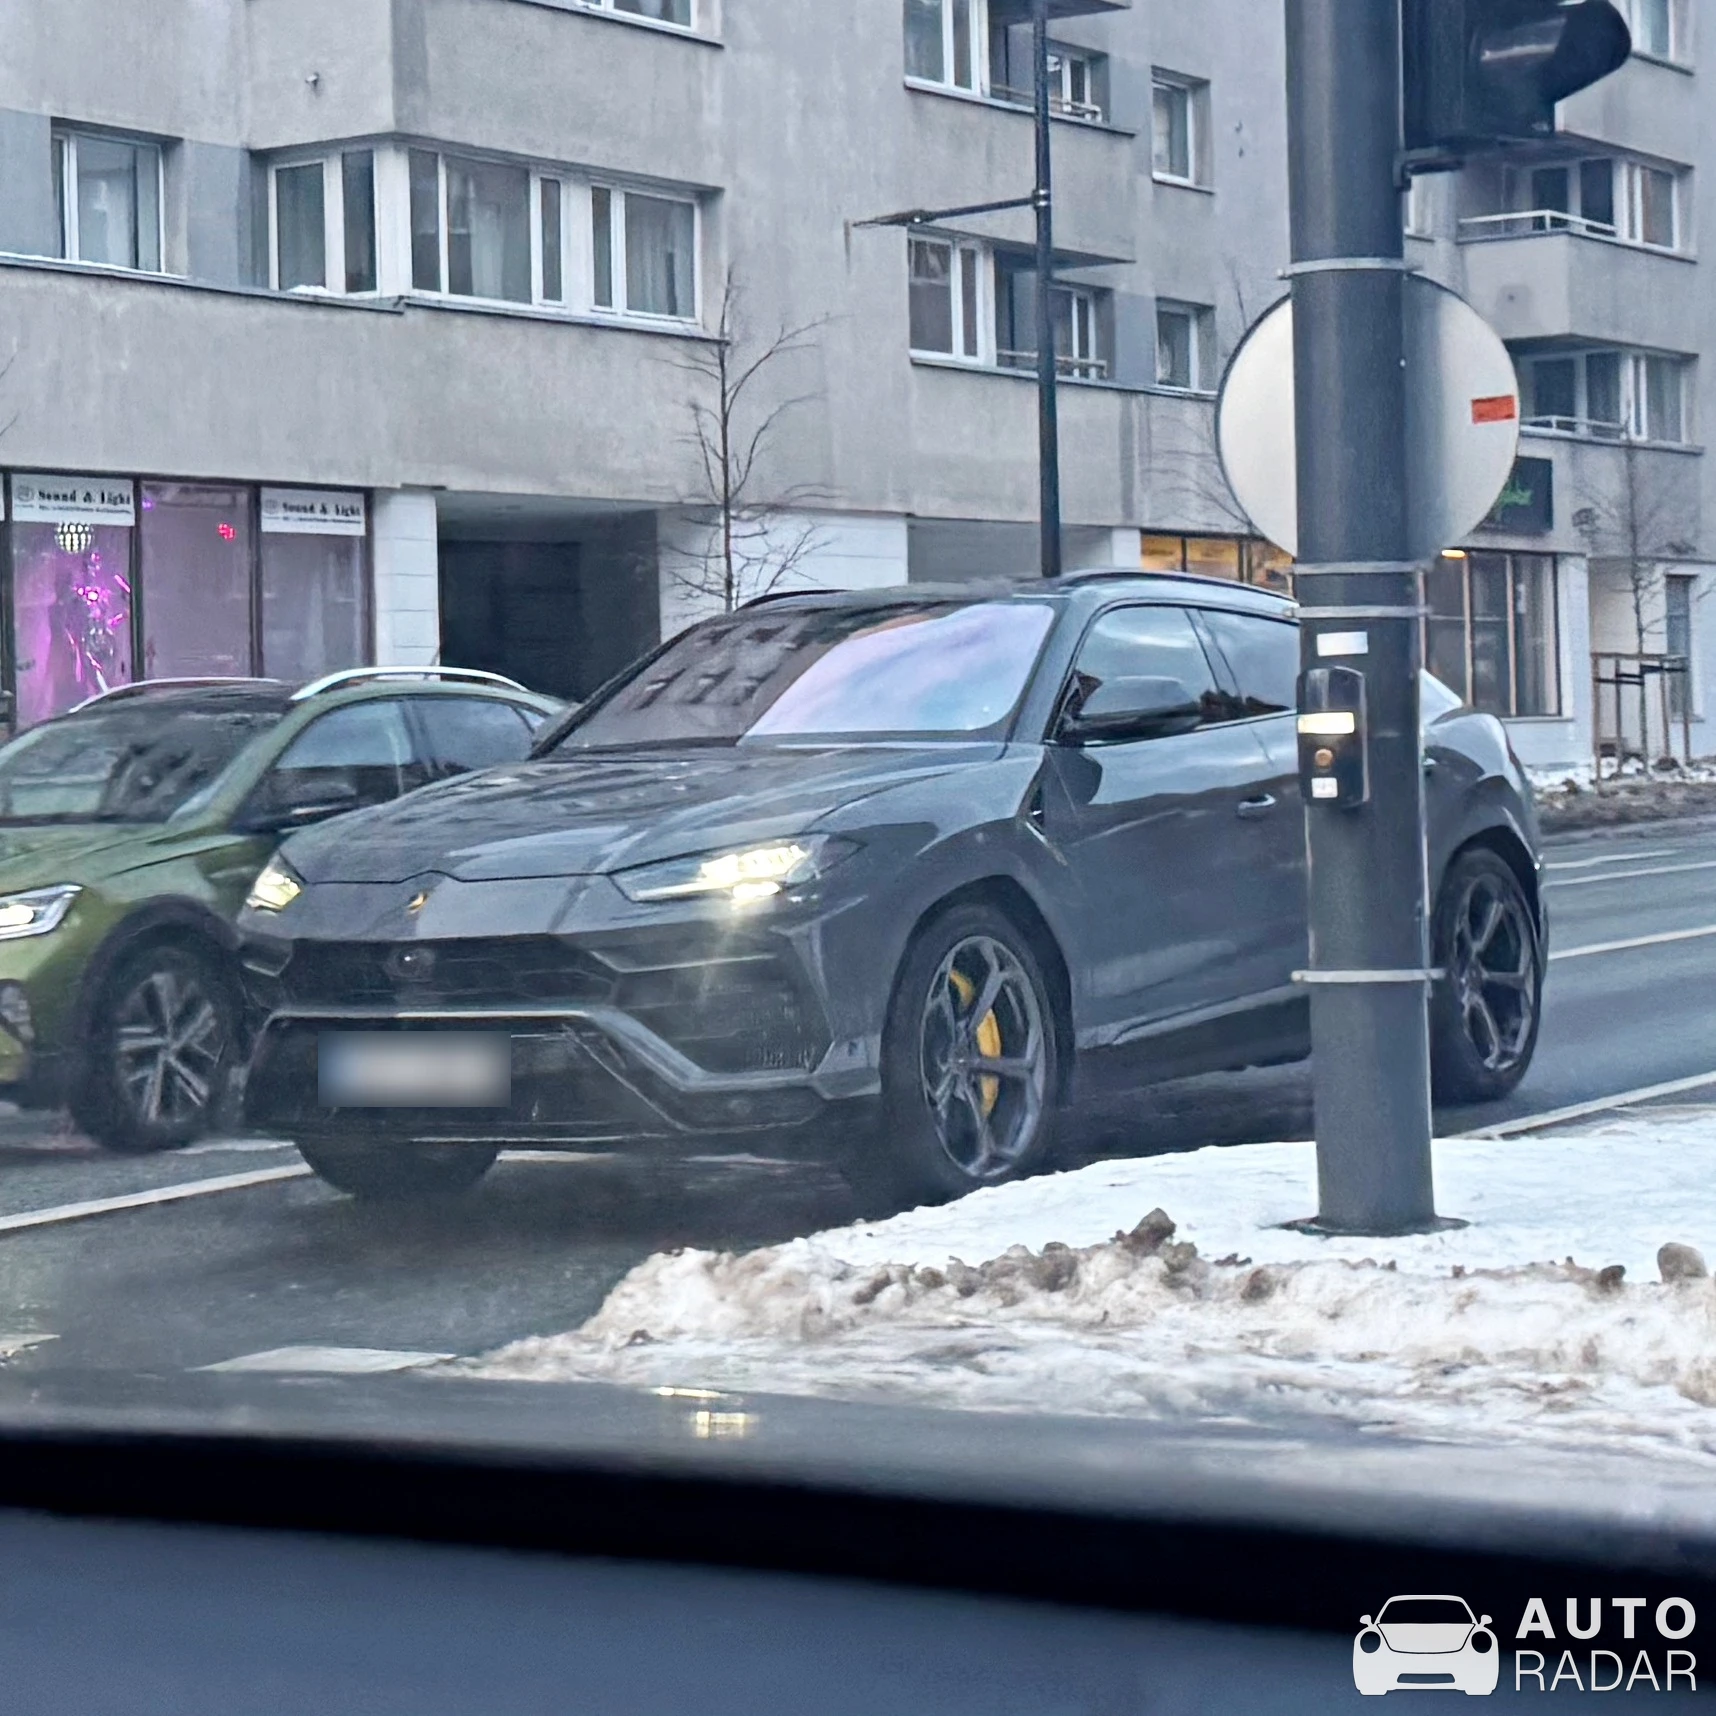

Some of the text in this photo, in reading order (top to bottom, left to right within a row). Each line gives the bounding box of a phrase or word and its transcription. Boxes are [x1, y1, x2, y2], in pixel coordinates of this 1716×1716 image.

[38, 490, 76, 502] Sound
[83, 490, 94, 503] &
[282, 502, 314, 513] Sound
